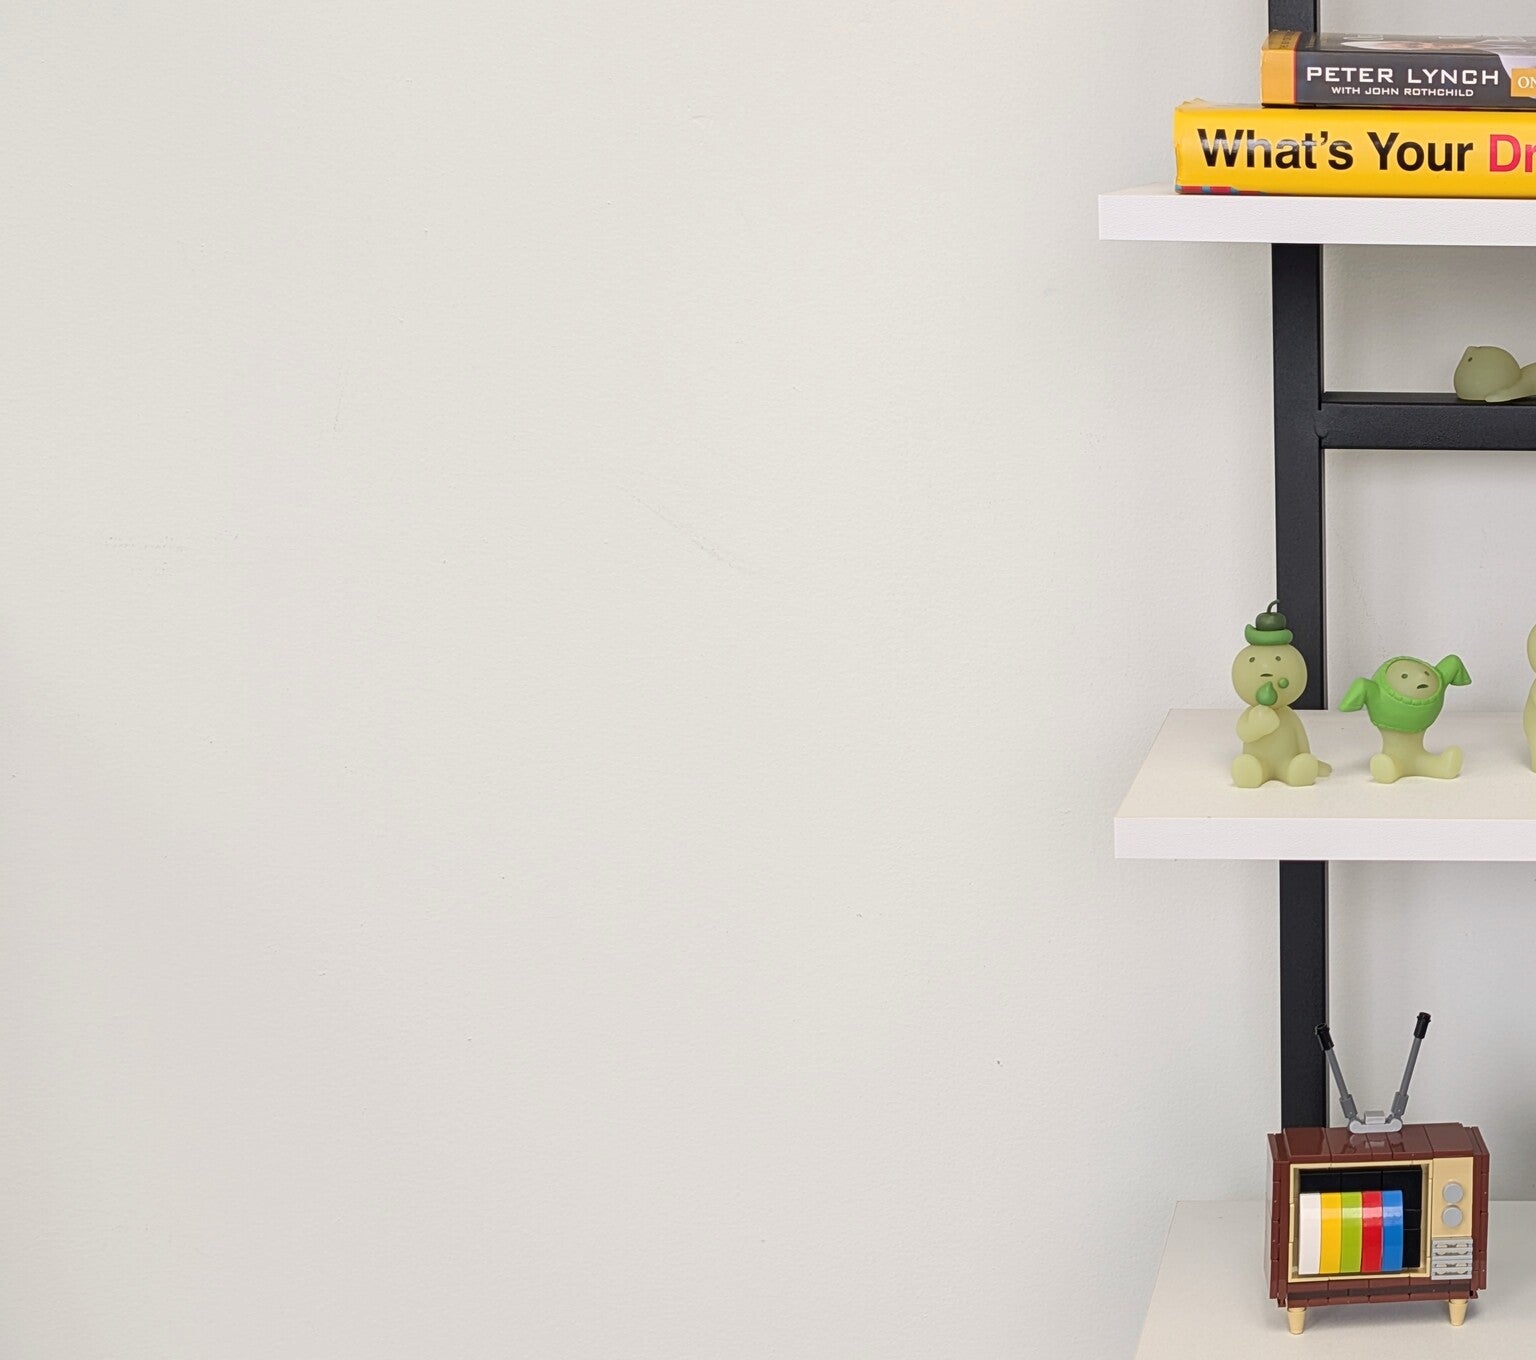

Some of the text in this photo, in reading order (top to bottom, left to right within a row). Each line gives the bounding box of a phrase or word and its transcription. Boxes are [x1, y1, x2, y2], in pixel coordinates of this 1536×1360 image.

[1306, 66, 1499, 85] PETER LYNCH
[1331, 86, 1474, 97] WITH JOHN ROTHCHILD
[1366, 131, 1474, 172] Your
